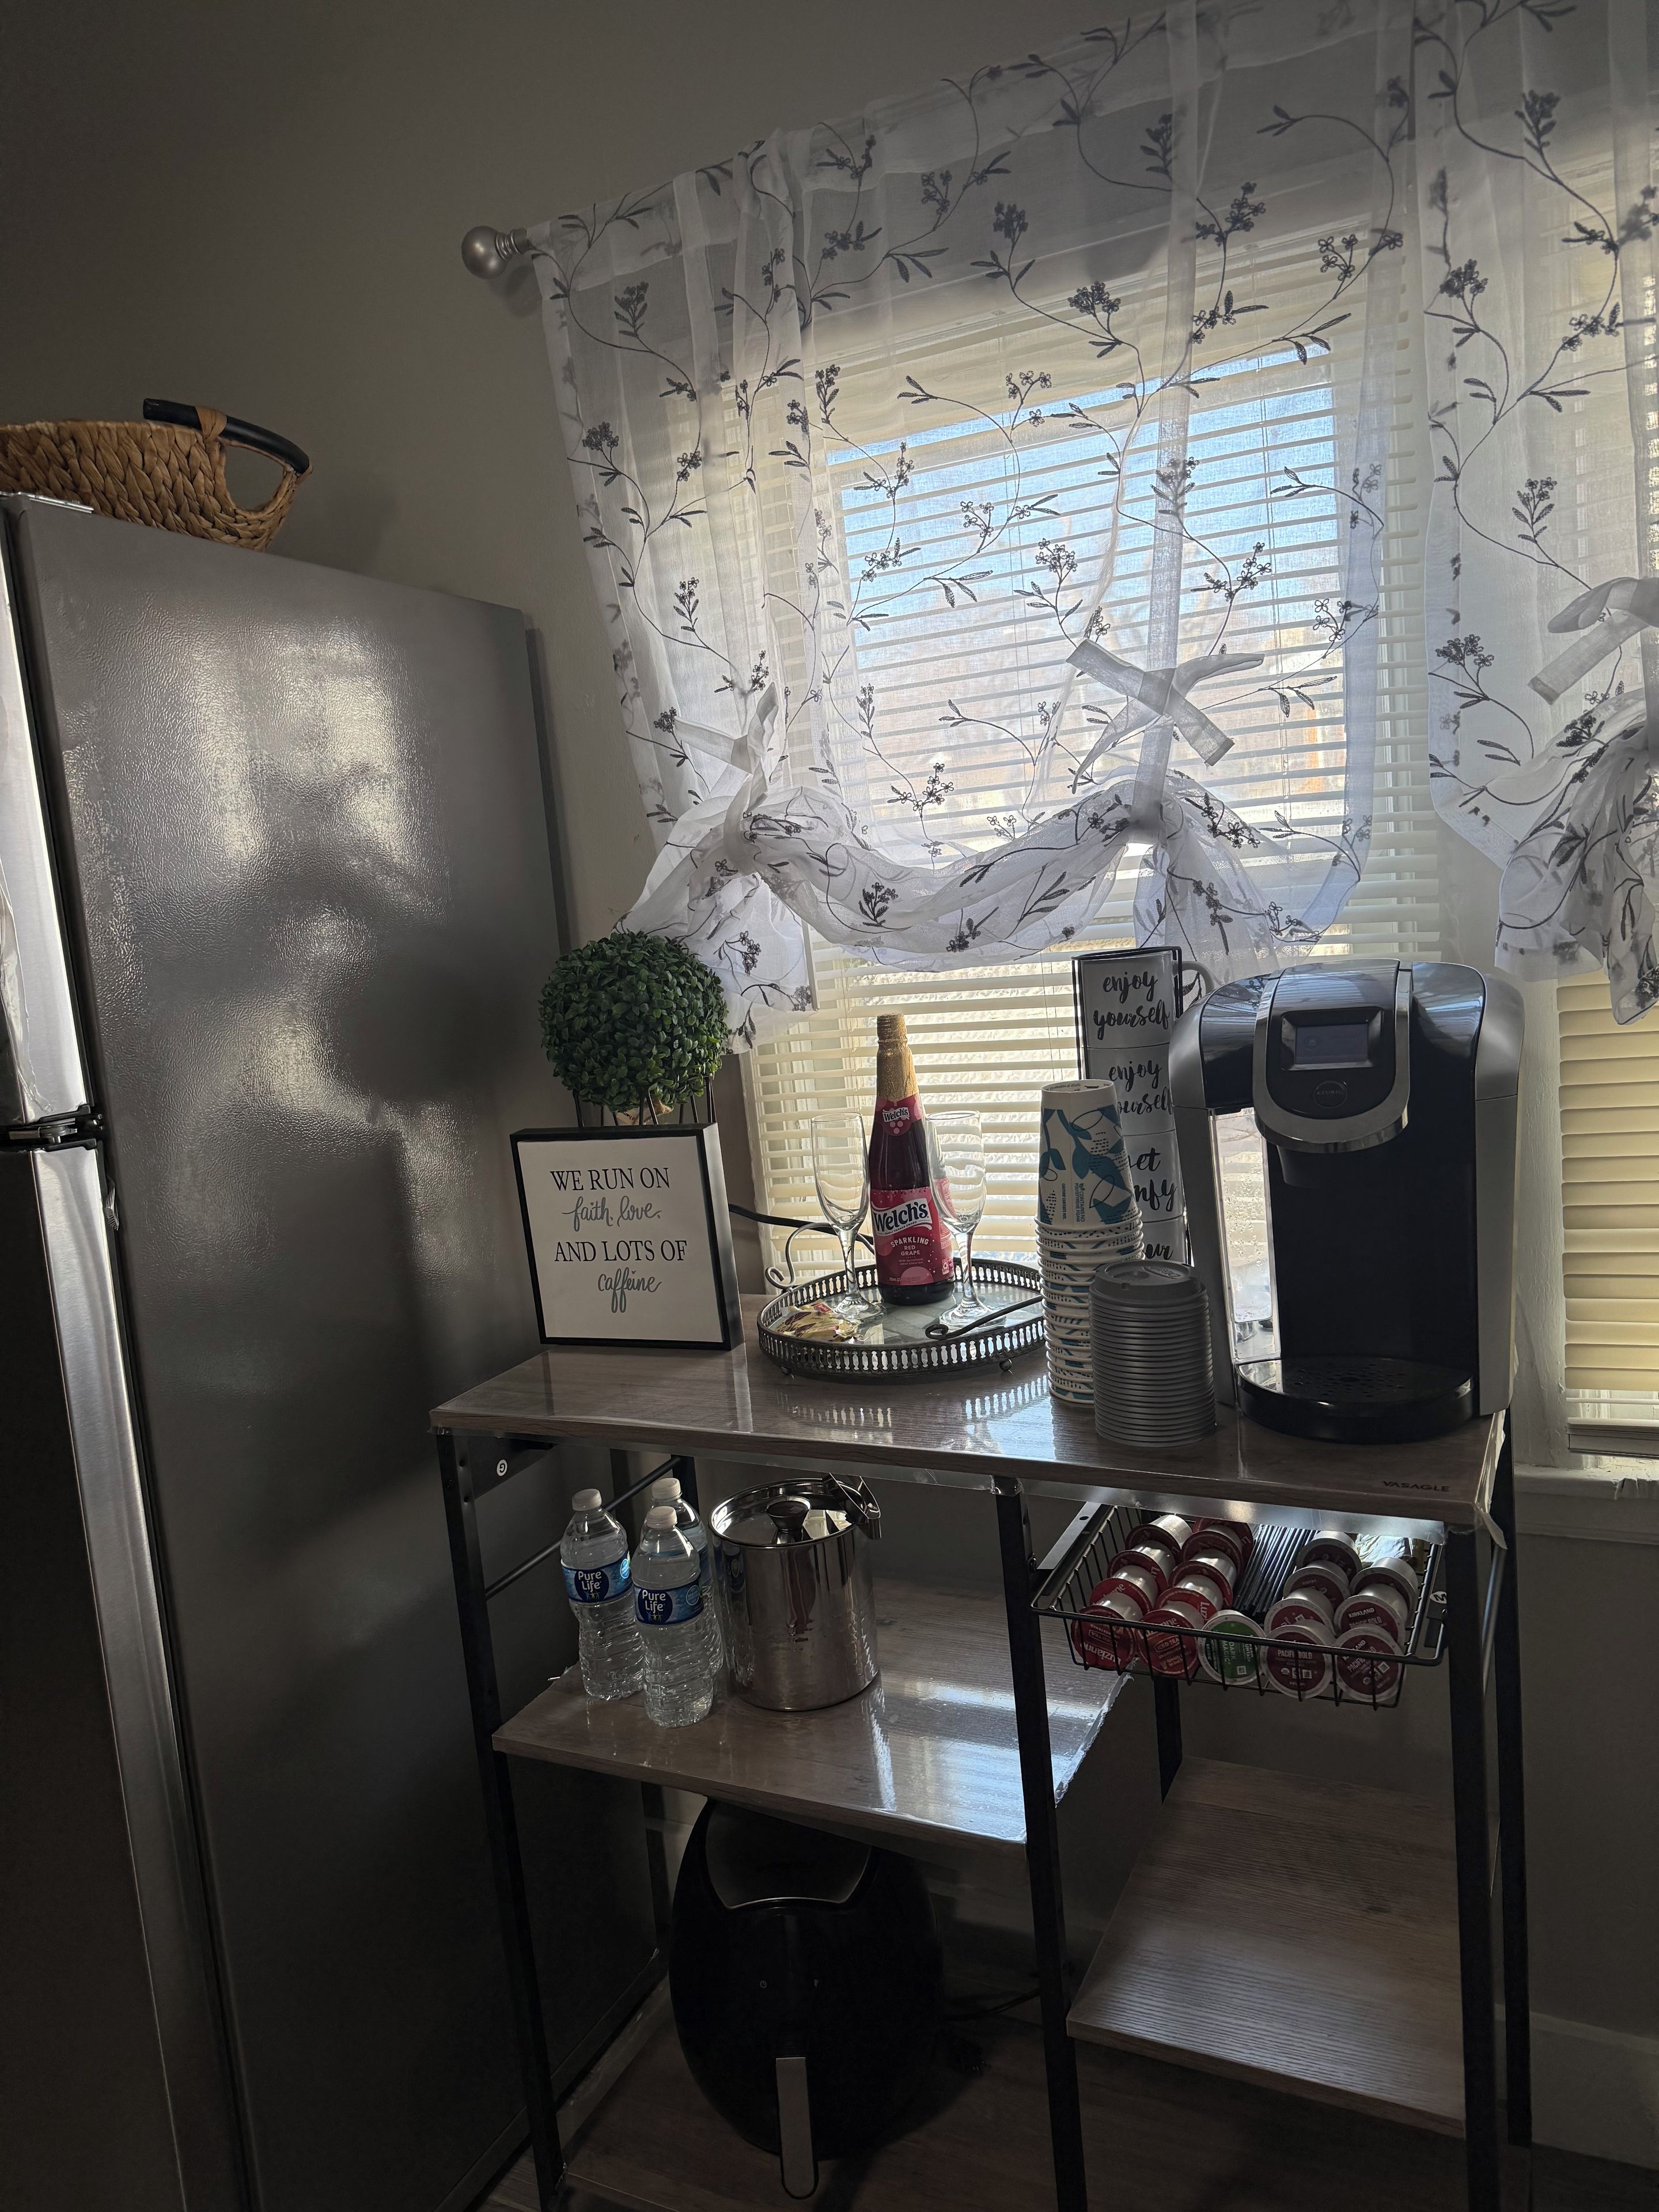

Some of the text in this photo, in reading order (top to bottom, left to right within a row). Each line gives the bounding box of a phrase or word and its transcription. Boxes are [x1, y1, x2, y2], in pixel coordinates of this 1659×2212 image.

[1103, 971, 1158, 1004] enjoy
[1093, 999, 1170, 1040] yourself
[1109, 1060, 1162, 1092] enjoy
[550, 1168, 670, 1191] WE RUN ON
[873, 1202, 929, 1232] Welch's
[554, 1240, 687, 1262] AND LOTS OF
[891, 1237, 929, 1248] SPARKLING
[597, 1267, 662, 1313] caffeine
[1383, 1481, 1450, 1492] VASAGLE
[578, 1570, 602, 1581] Pure
[581, 1580, 601, 1593] Life
[642, 1590, 666, 1601] Pure
[645, 1600, 665, 1612] Life
[1348, 1608, 1374, 1618] KIRKLAND
